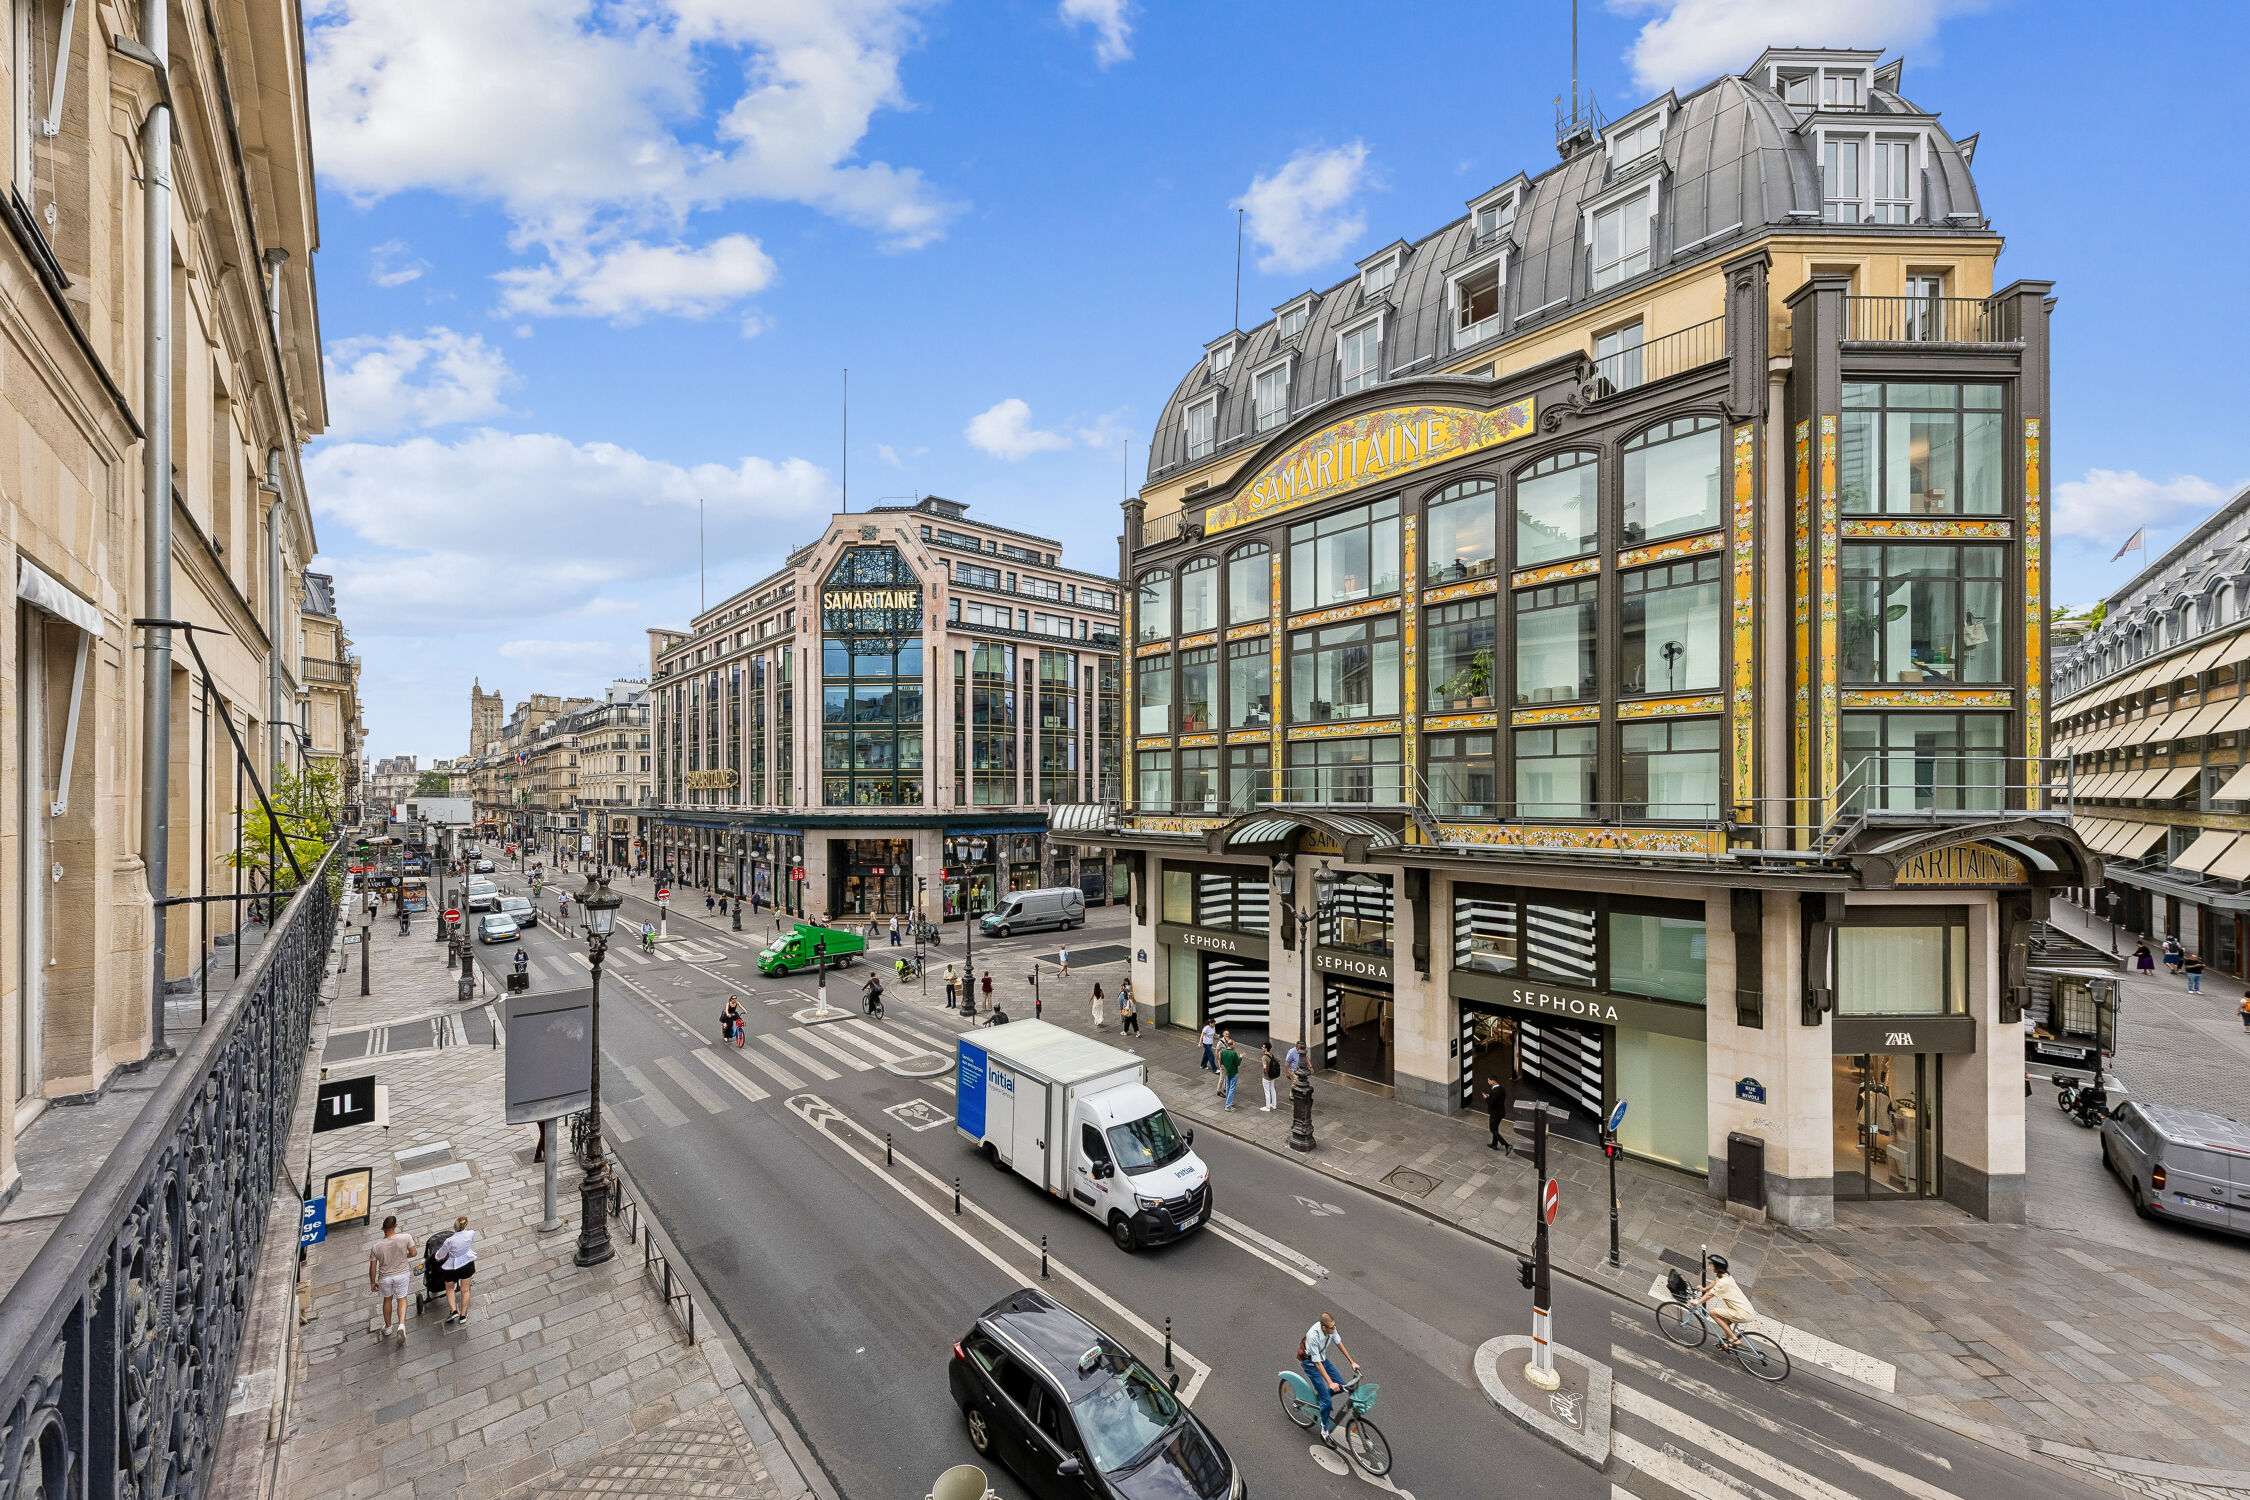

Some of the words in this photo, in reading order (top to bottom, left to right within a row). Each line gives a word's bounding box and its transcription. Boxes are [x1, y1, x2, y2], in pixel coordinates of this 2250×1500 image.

[1251, 417, 1447, 510] SAMARITAINE
[823, 591, 918, 610] SAMARITAINE
[687, 769, 731, 789] SAMARITAINE
[1183, 933, 1236, 951] SEPHORA
[1317, 955, 1388, 978] SEPHORA
[1513, 989, 1619, 1021] SEPHORA
[1885, 1032, 1915, 1046] ZARA
[988, 1066, 1015, 1093] Initial
[1742, 1093, 1760, 1101] RIVOLI
[1174, 1165, 1196, 1179] Initial
